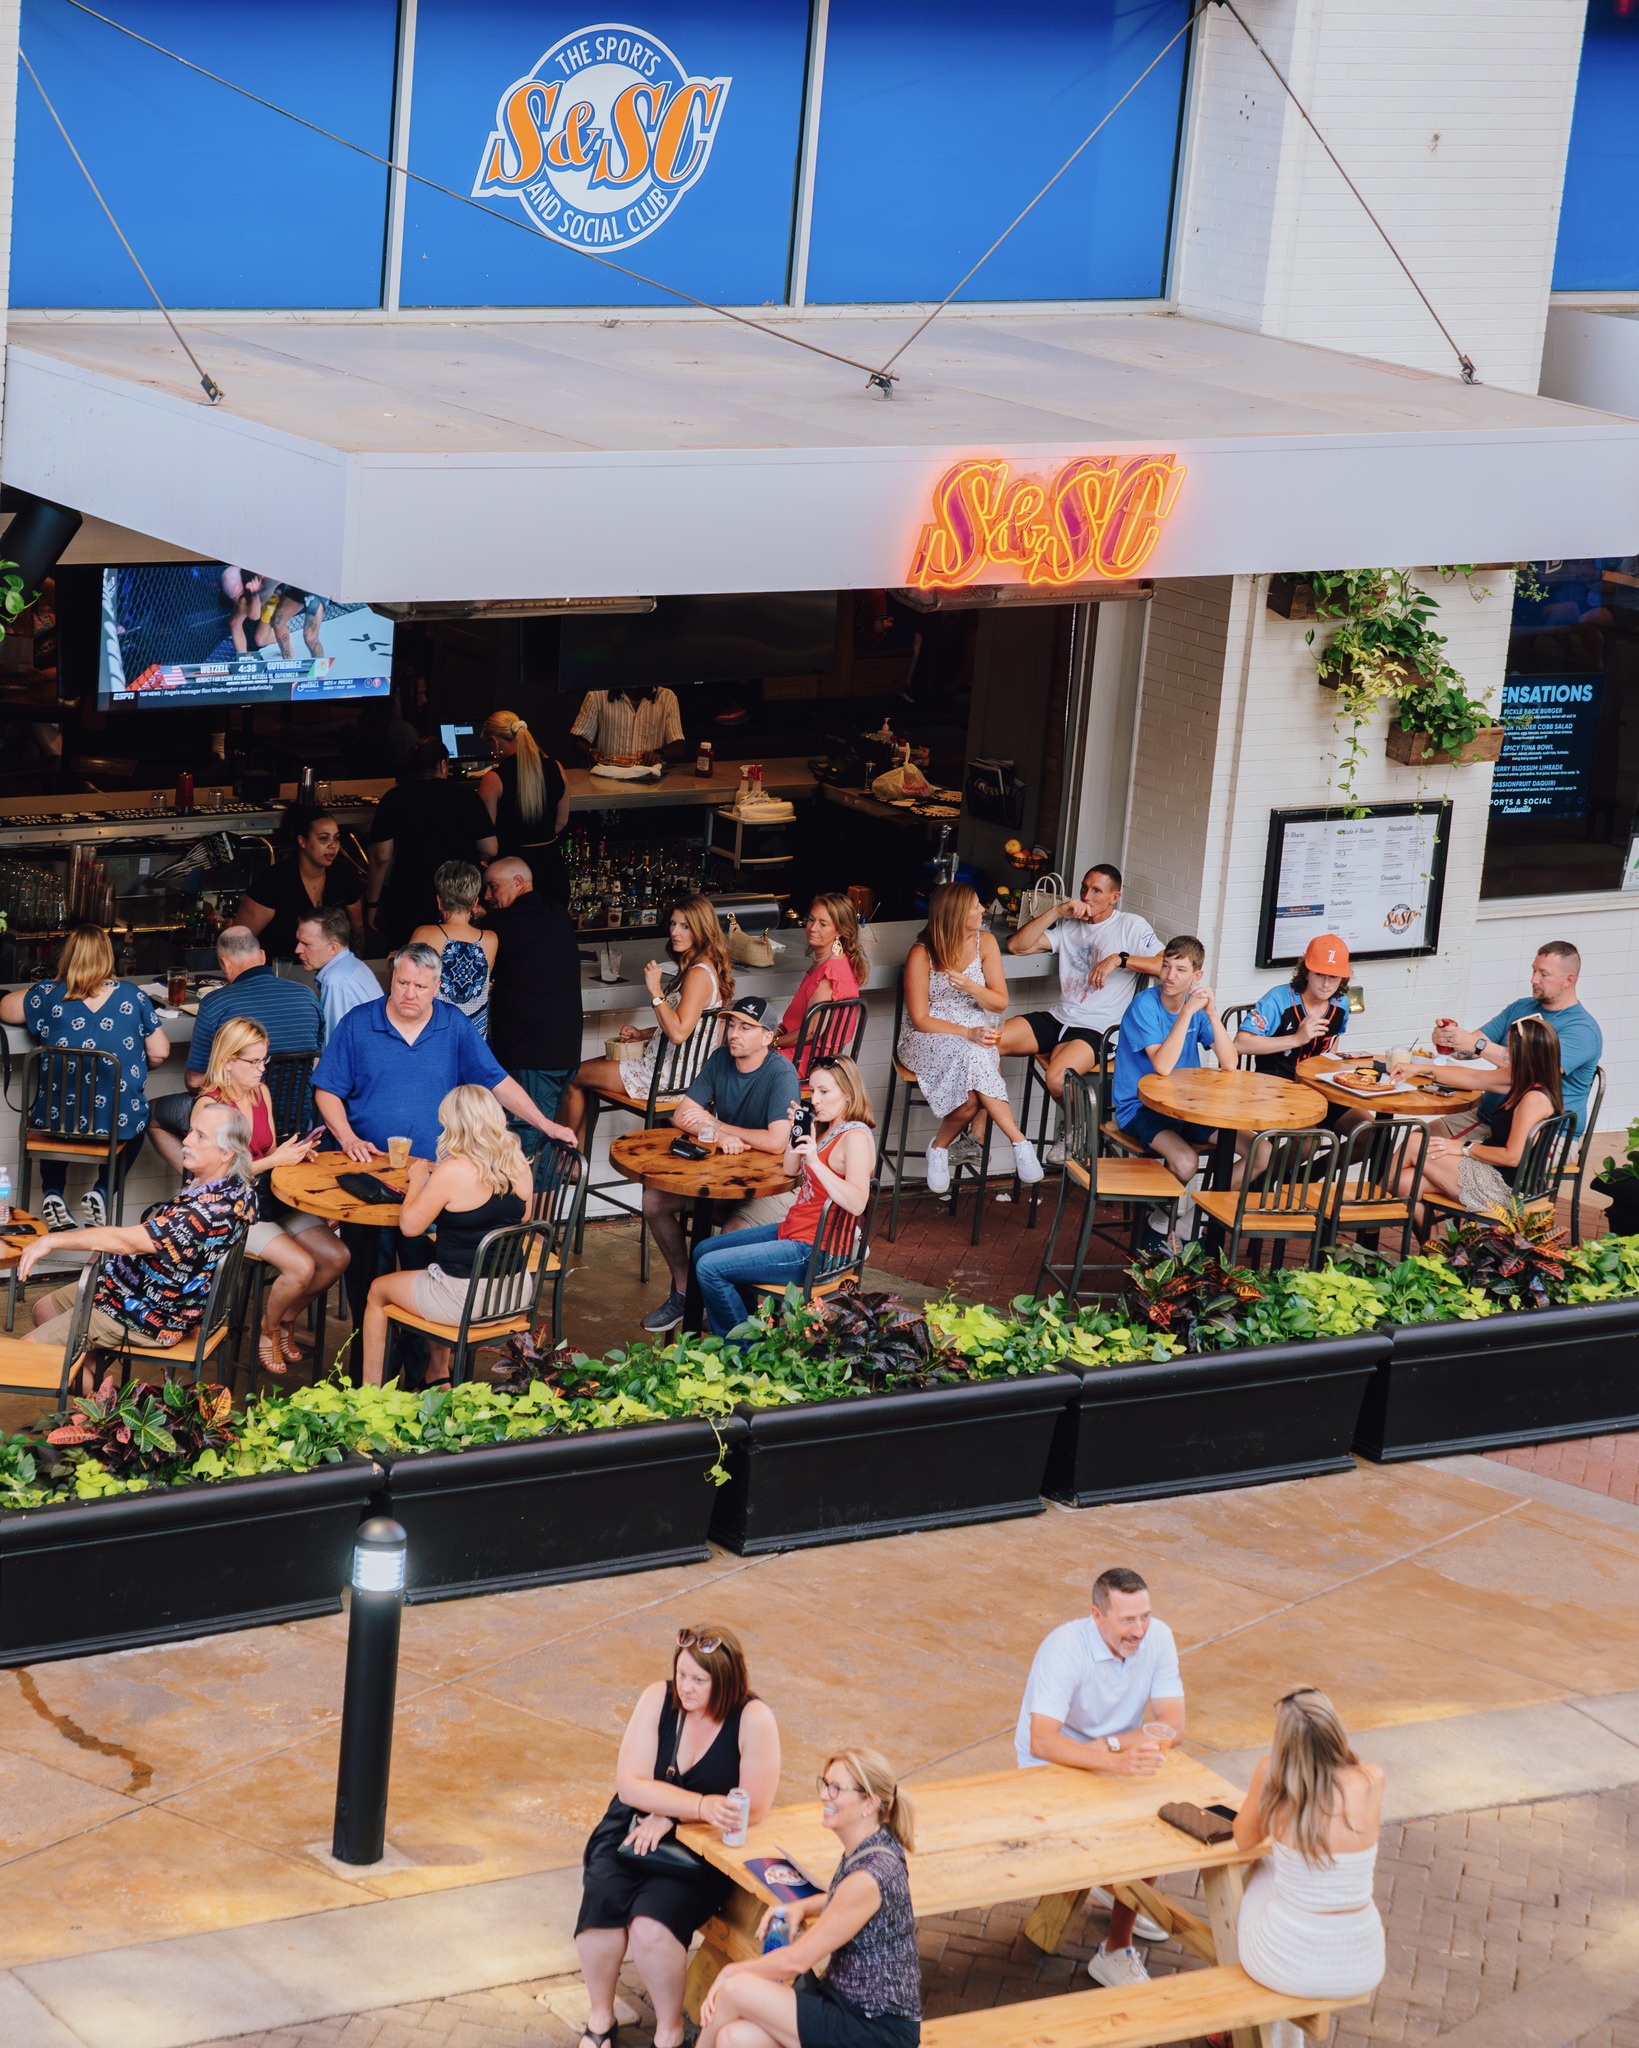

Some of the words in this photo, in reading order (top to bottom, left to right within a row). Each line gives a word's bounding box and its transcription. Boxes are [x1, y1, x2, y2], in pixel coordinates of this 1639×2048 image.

[555, 40, 592, 75] THE
[595, 36, 661, 77] SPORTS
[480, 80, 724, 191] S&SC
[526, 181, 561, 221] AND
[558, 209, 624, 243] SOCIAL
[626, 188, 669, 233] CLUB
[906, 454, 1187, 588] S&SC
[200, 664, 229, 674] WETZELL
[238, 664, 257, 673] 4:38
[267, 661, 302, 670] GUTIERREZ
[113, 692, 135, 700] ESPN
[1502, 805, 1532, 813] Louisville
[1327, 949, 1336, 964] L
